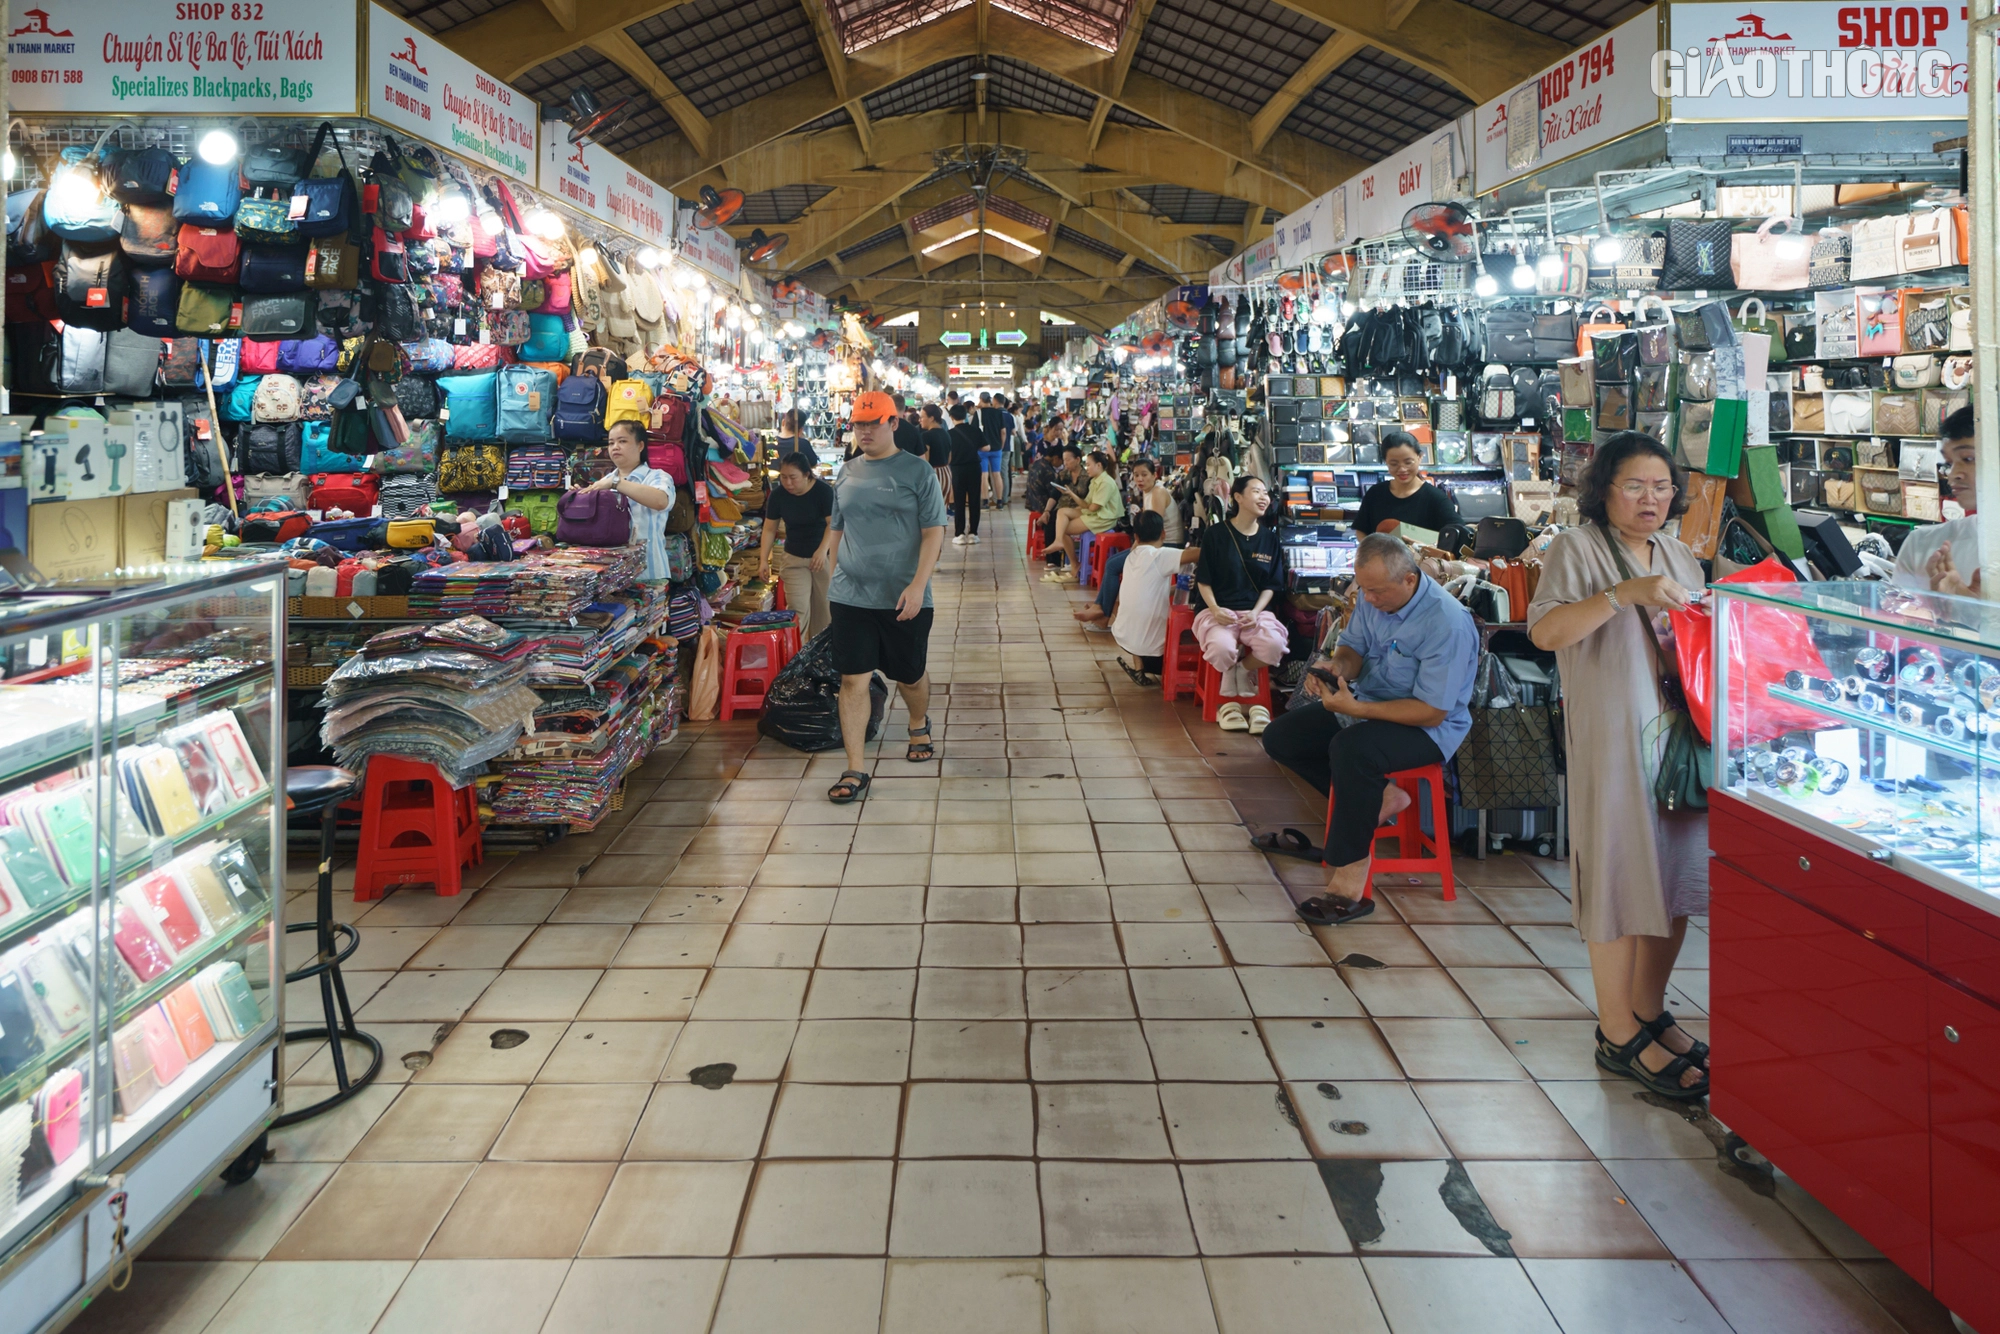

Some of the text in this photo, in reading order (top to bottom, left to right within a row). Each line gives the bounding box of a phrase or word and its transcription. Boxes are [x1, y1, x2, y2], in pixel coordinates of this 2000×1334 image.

[176, 2, 264, 21] SHOP 832
[1838, 7, 1949, 47] SHOP
[16, 43, 42, 54] THANH
[43, 43, 76, 54] MARKET
[103, 30, 323, 72] Chuyên Sỉ Lẻ Ba Lô, Túi Xách
[1706, 46, 1796, 56] BEN THANH MARKET
[12, 69, 83, 84] 0908 671 588
[389, 63, 429, 93] BEN THANH MARKET
[1540, 37, 1615, 110] HOP 794
[112, 75, 189, 100] Specializes
[280, 77, 313, 102] Bags
[475, 73, 511, 107] SHOP 832
[395, 90, 410, 111] 0908
[410, 97, 420, 117] 671
[420, 102, 431, 121] 588
[443, 83, 472, 124] Chuyên
[489, 107, 498, 133] Ba
[518, 122, 533, 151] Xách
[1540, 113, 1563, 148] Túi
[1562, 93, 1603, 139] Xách
[451, 123, 484, 154] Specializes
[515, 154, 527, 177] Bags
[626, 171, 637, 189] SHOP
[1362, 175, 1375, 201] 792
[1399, 161, 1422, 196] GIÀY
[1728, 186, 1785, 198] FENDI
[328, 248, 341, 275] FACE
[1909, 248, 1933, 257] BURBERRY
[149, 289, 158, 317] FACE
[252, 305, 280, 318] FACE
